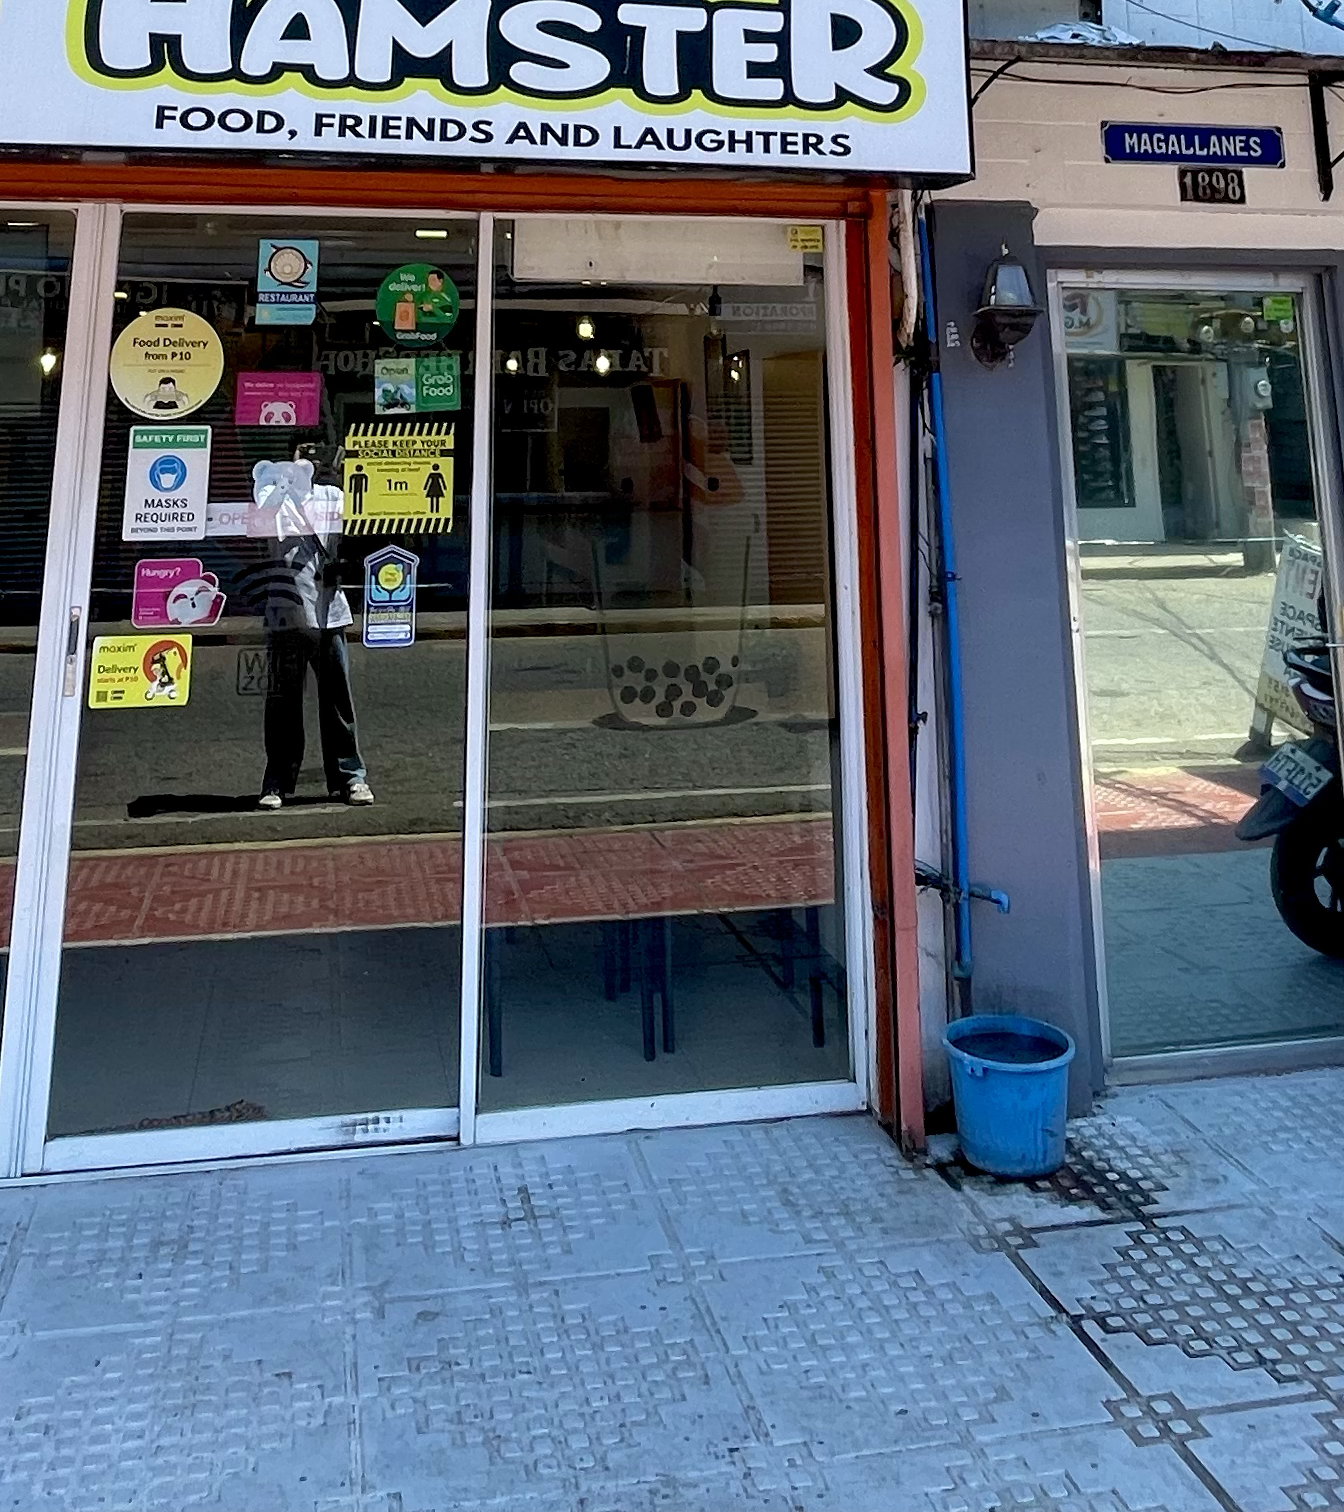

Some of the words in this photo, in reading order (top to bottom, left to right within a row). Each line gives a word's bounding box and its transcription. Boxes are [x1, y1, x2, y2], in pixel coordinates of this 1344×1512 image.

[154, 105, 298, 141] FOOD,
[313, 112, 495, 144] FRIENDS
[505, 120, 601, 149] AND
[612, 125, 853, 158] LAUGHTERS
[1124, 132, 1263, 158] MAGALLANES
[1182, 171, 1242, 201] 1898
[388, 281, 426, 293] deliver!
[258, 292, 315, 303] RESTAURANT
[154, 314, 185, 323] maxim
[395, 332, 438, 341] GrabFood
[132, 337, 160, 348] Food
[162, 337, 209, 351] Delivery
[143, 351, 168, 361] from
[380, 365, 409, 377] Open
[421, 372, 453, 386] Grab
[421, 384, 454, 397] Food
[134, 434, 174, 444] SAFETY
[175, 433, 206, 443] FIRST
[352, 439, 389, 449] PLEASE
[392, 439, 417, 448] KEEP
[420, 439, 447, 448] YOUR
[357, 449, 394, 459] SOCIAL
[395, 448, 441, 458] DISTANCE
[386, 478, 409, 492] 1m
[143, 498, 189, 510] MASKS
[134, 511, 196, 524] REQUIRED
[130, 526, 158, 534] BEYOND
[140, 566, 182, 580] Hungry?
[98, 644, 136, 654] maxim
[97, 663, 140, 676] Delivery
